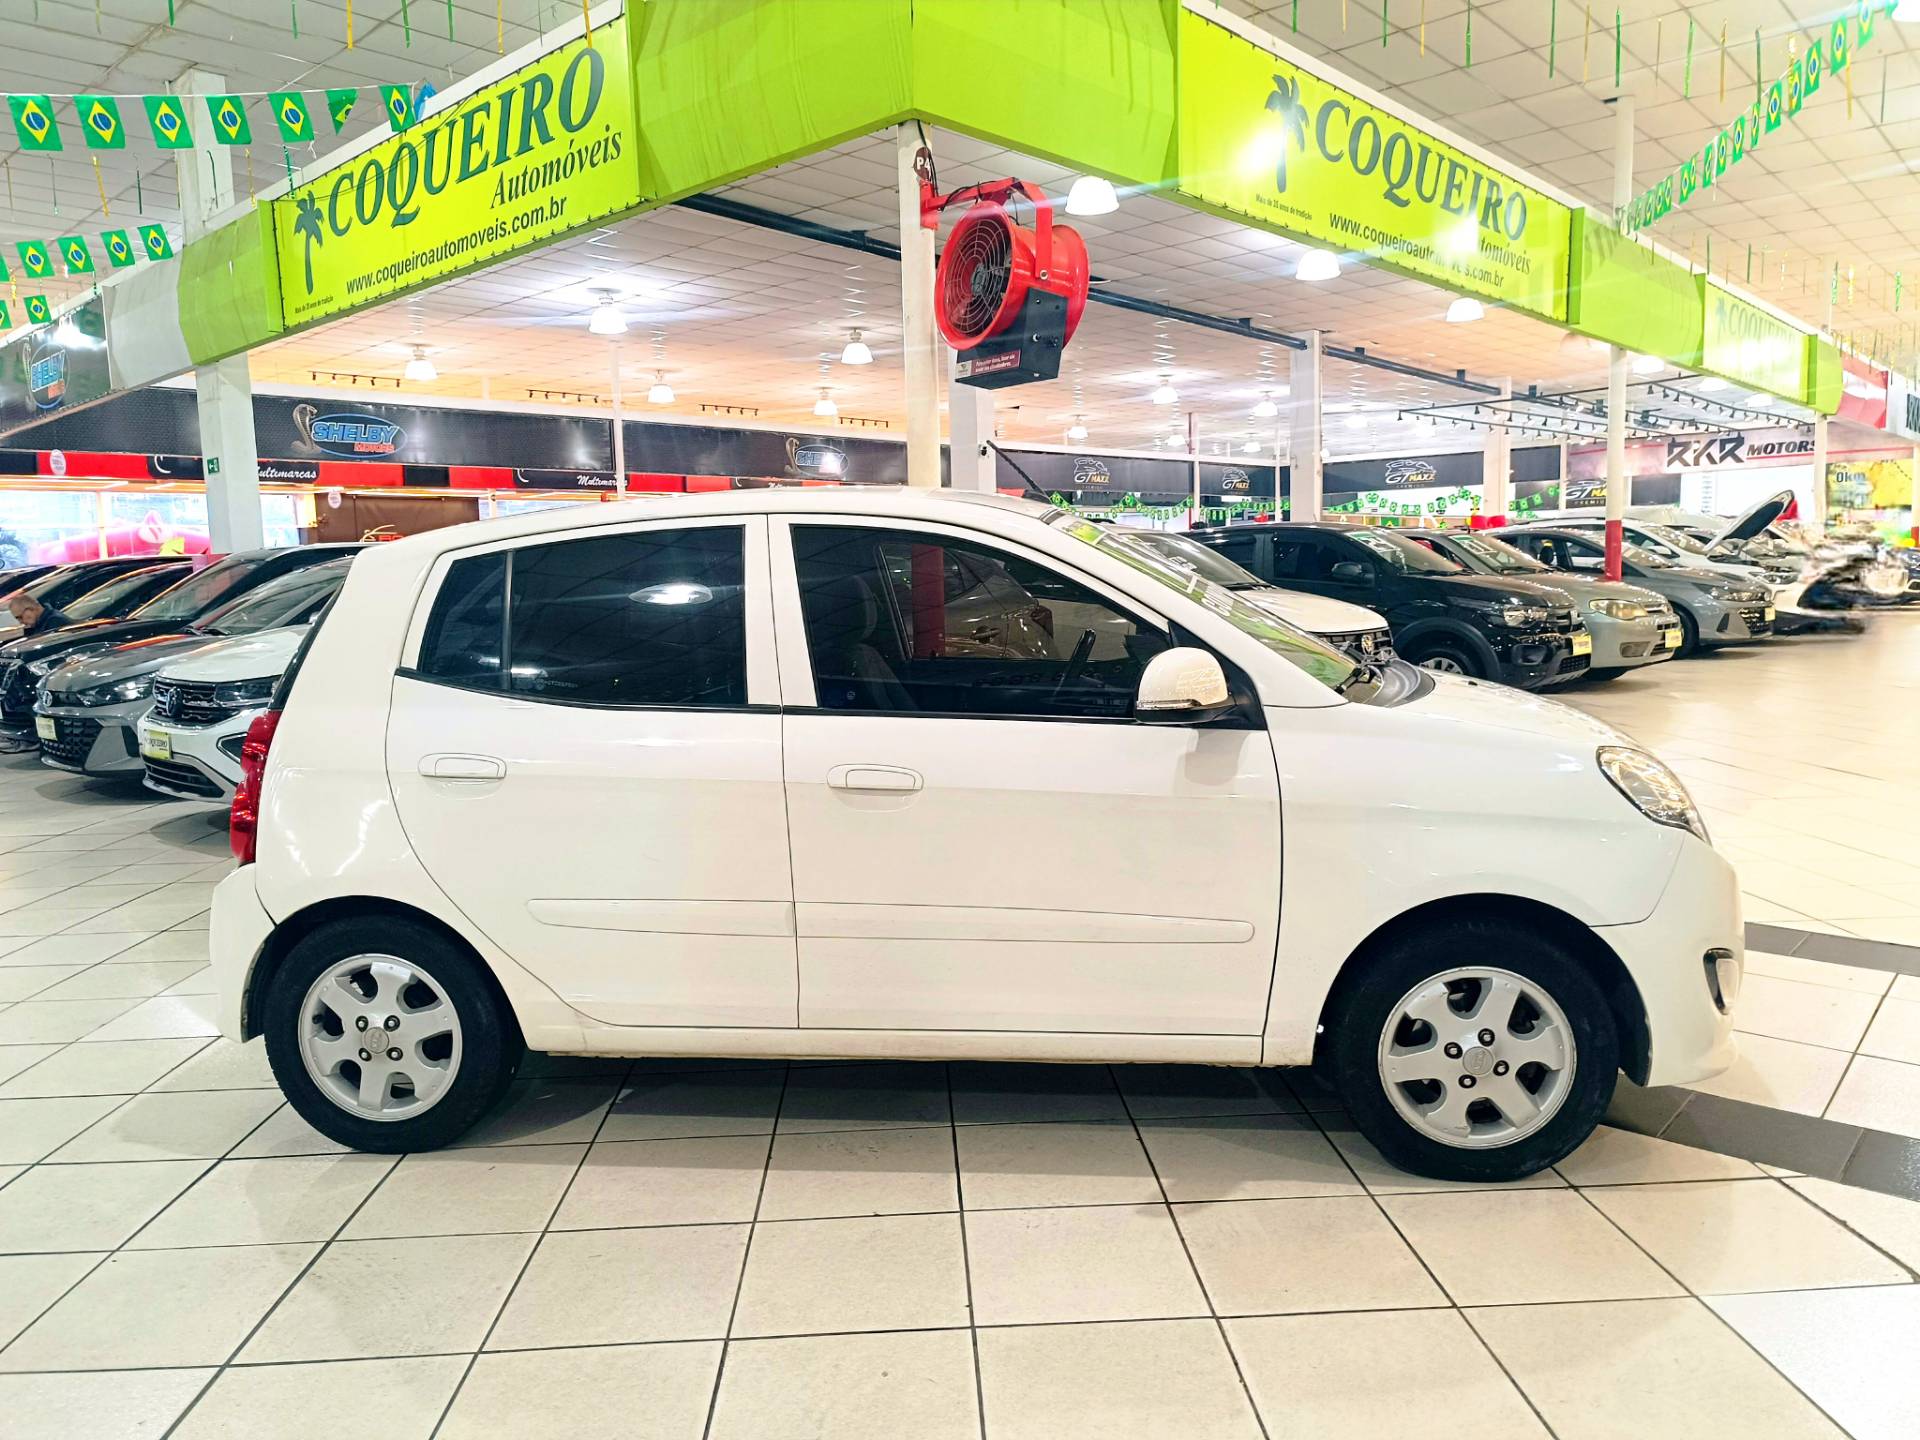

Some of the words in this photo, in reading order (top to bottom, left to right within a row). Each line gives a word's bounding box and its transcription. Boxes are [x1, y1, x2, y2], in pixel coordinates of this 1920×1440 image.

[328, 47, 605, 237] COQUEIRO
[490, 123, 623, 209] Automóveis
[1315, 99, 1527, 240] COQUEIRO
[346, 195, 567, 295] www.coqueiroautomoveis.com.br
[1329, 212, 1504, 288] www.coqueiroautomves.com.br
[1475, 235, 1532, 276] tomóveis
[311, 421, 400, 444] SHELBY
[1667, 436, 1745, 468] RKR
[576, 474, 628, 487] Multimars
